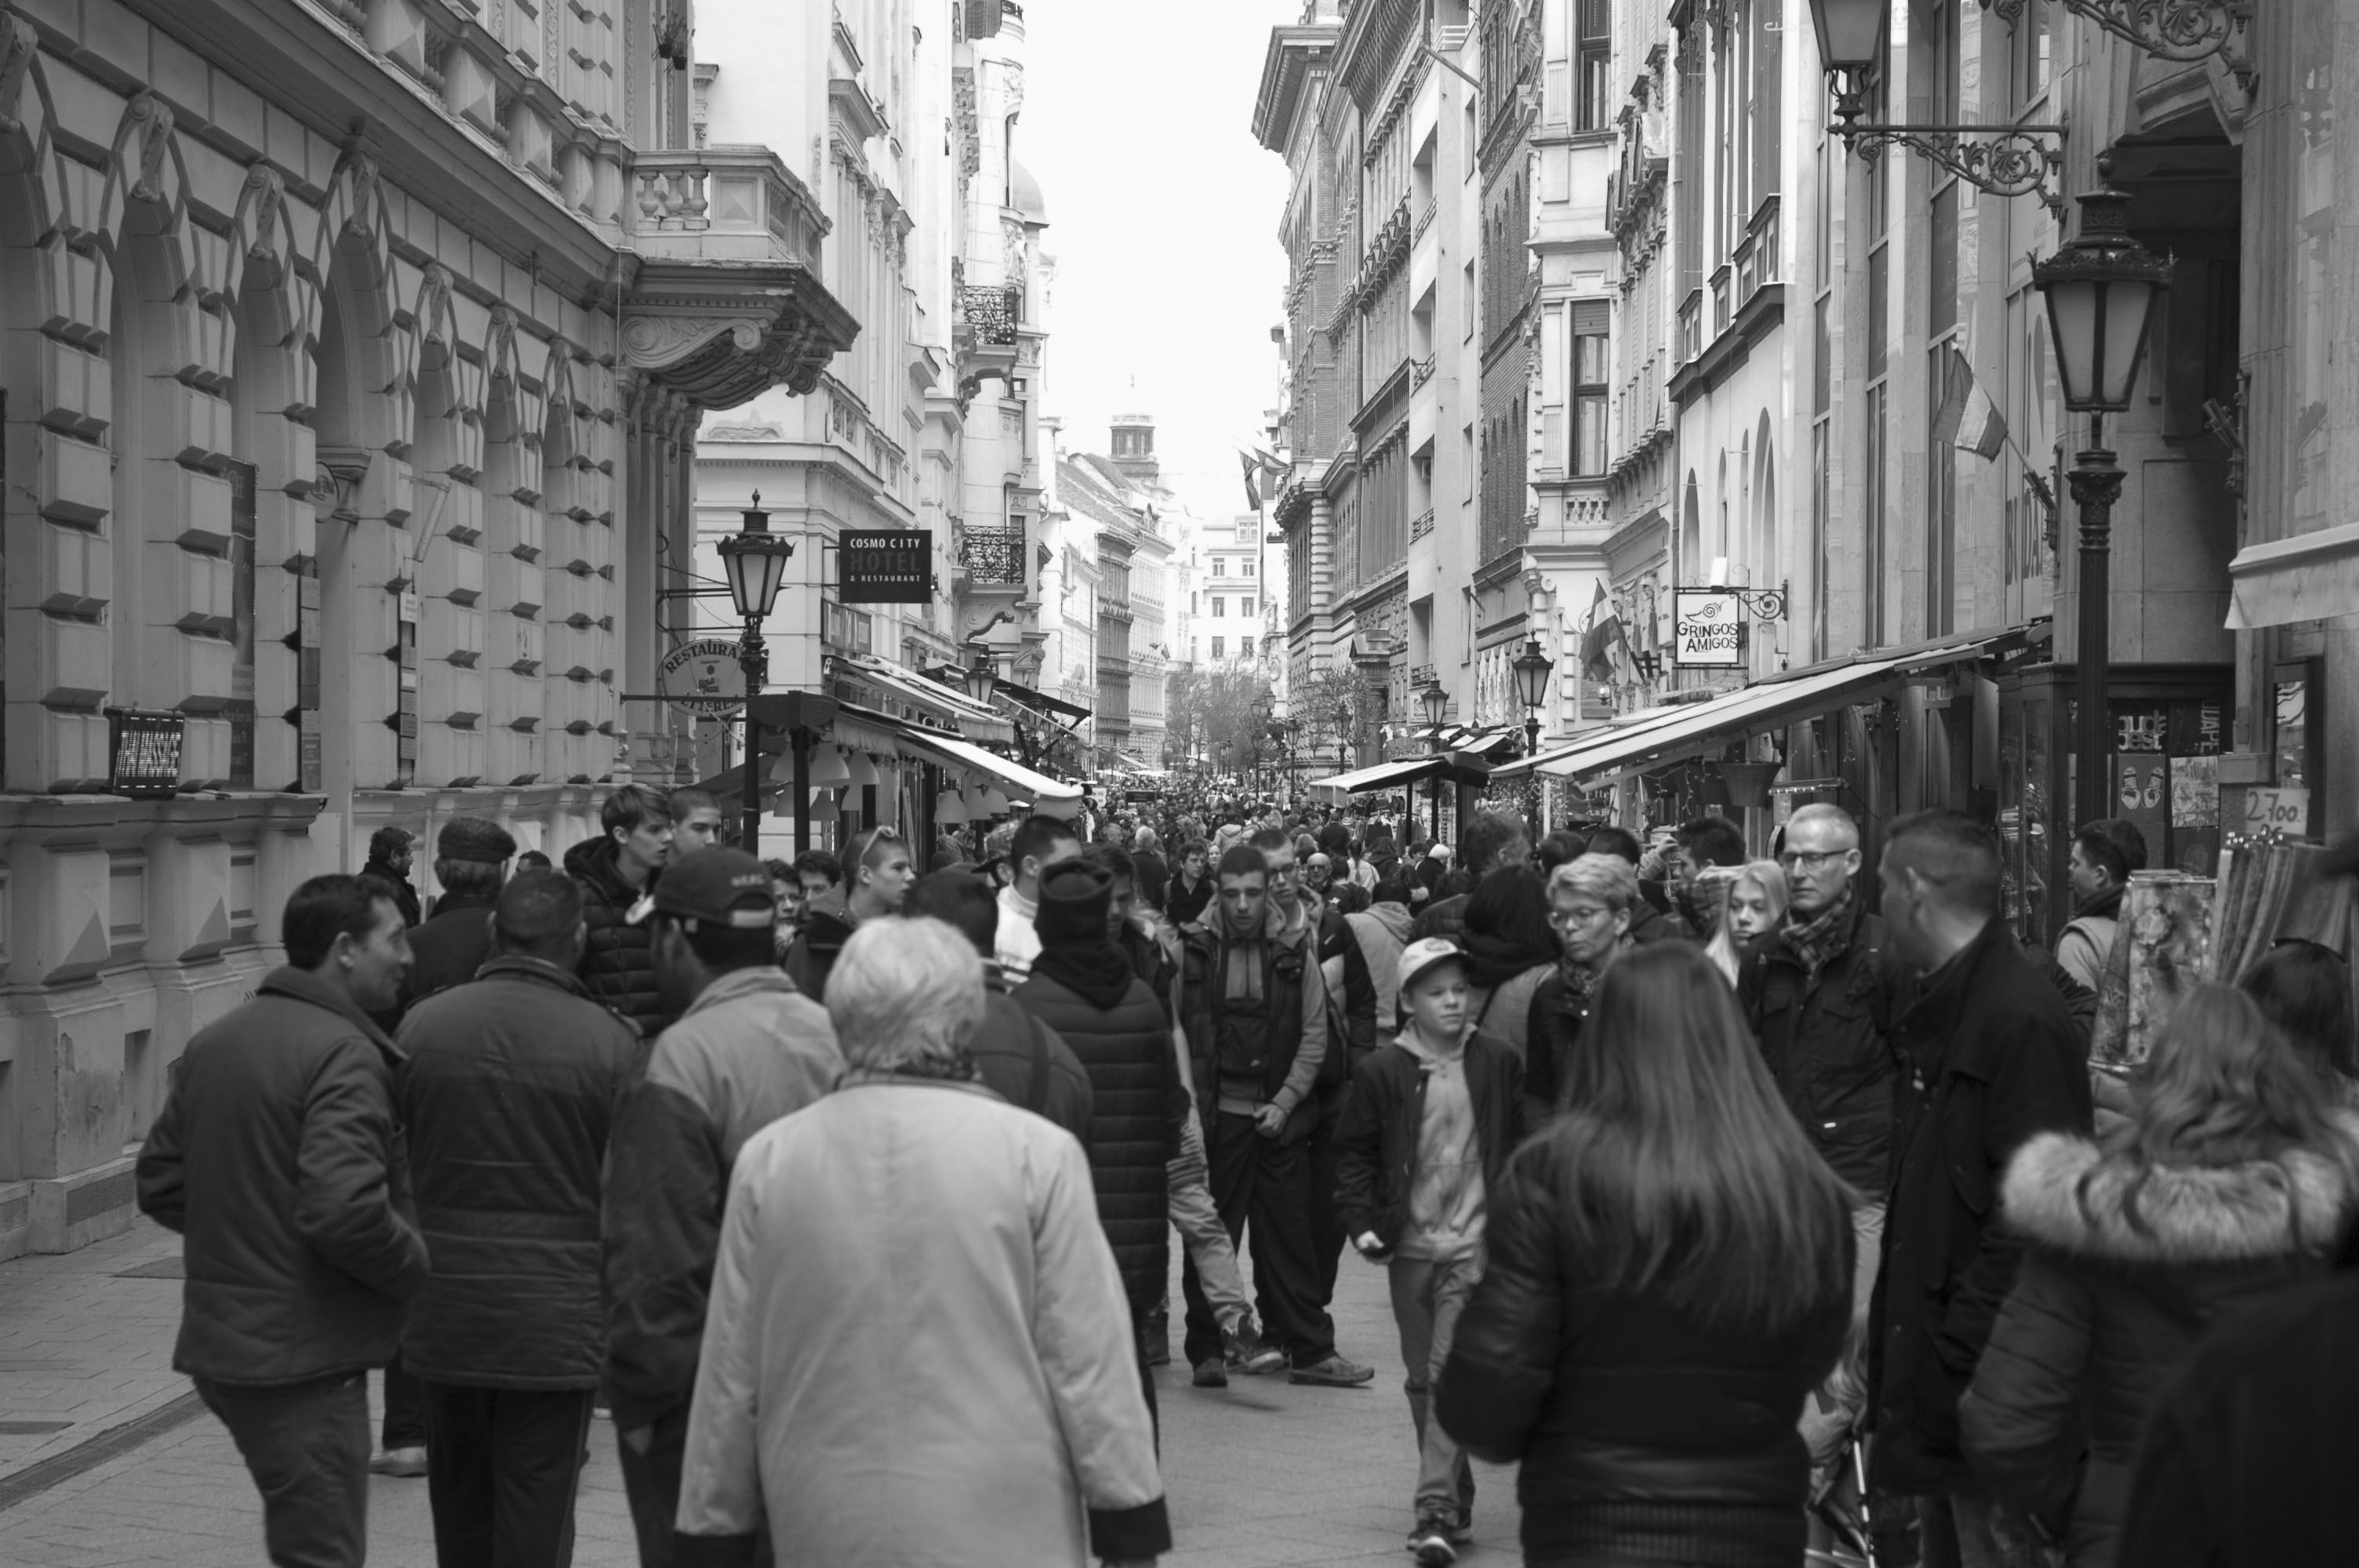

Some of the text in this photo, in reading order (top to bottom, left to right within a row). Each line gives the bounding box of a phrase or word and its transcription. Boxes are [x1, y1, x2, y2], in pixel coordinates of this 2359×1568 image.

[850, 538, 920, 549] COSMO CITY
[850, 551, 920, 572] HOTEL
[1677, 622, 1738, 638] GRINGOS
[1685, 637, 1738, 653] AMIGOS
[664, 643, 739, 674] RESTAURA
